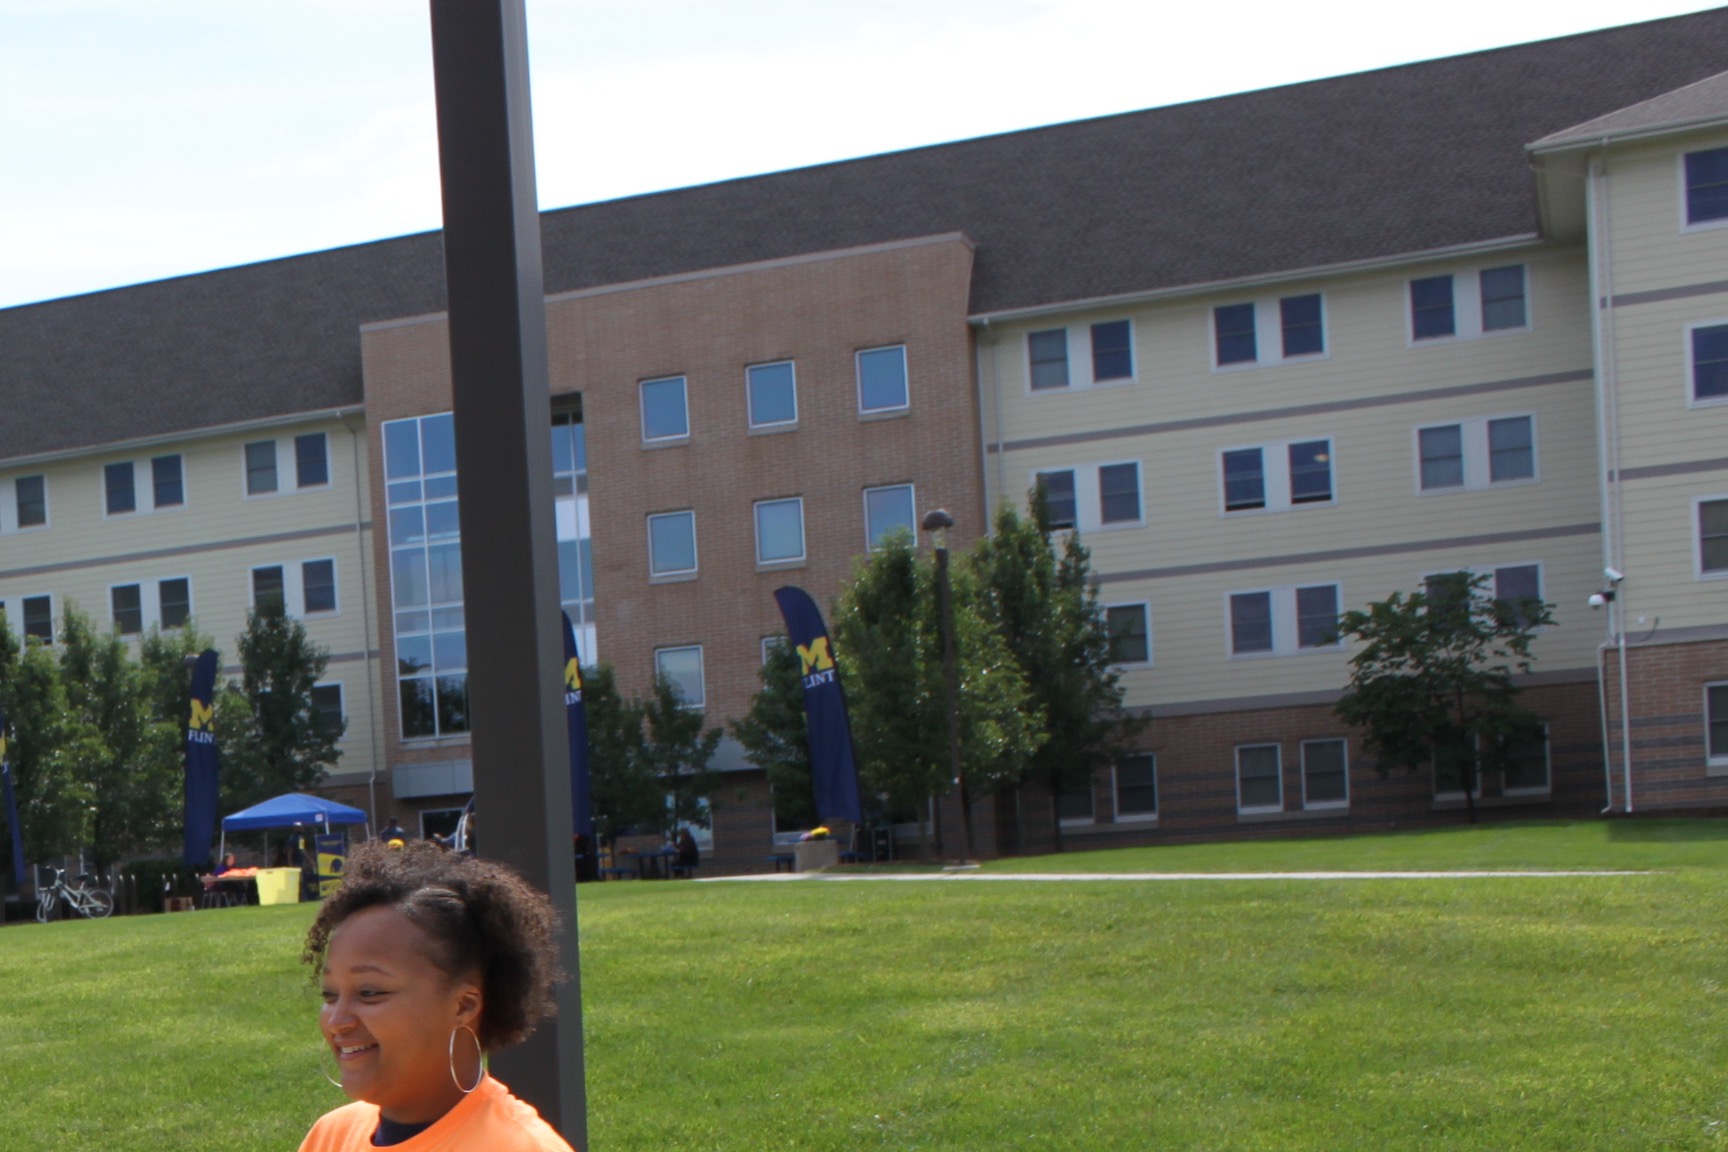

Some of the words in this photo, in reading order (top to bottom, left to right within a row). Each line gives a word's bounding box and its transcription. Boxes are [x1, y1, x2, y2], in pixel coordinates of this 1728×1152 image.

[796, 636, 835, 677] M
[803, 669, 835, 689] LINT
[189, 698, 215, 732] M
[187, 729, 215, 744] FLIN
